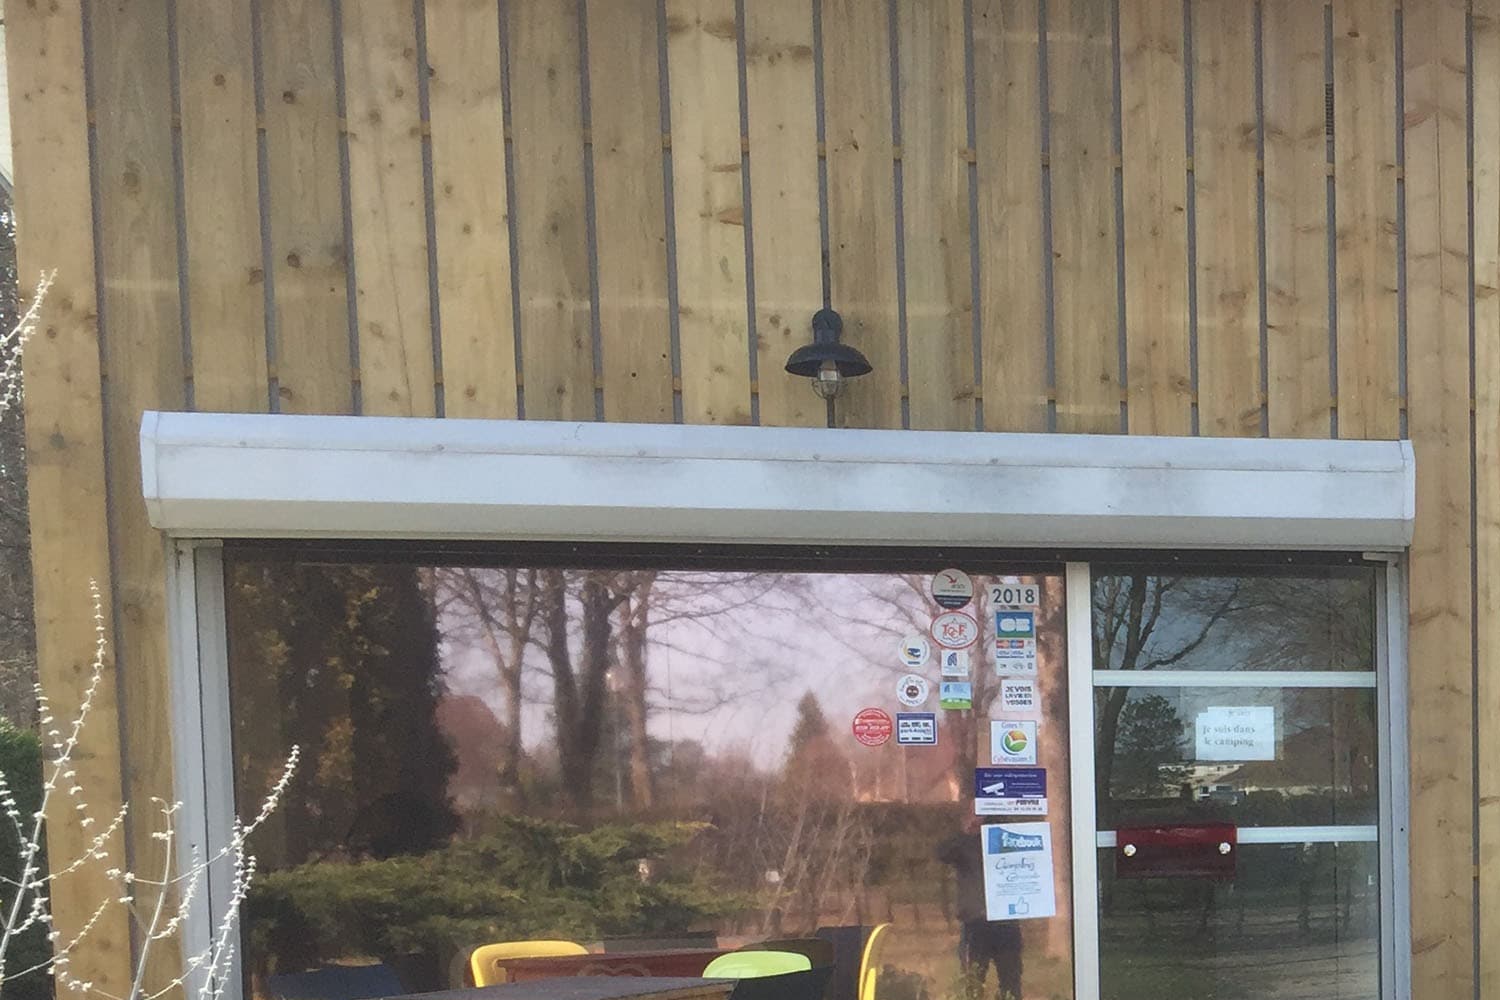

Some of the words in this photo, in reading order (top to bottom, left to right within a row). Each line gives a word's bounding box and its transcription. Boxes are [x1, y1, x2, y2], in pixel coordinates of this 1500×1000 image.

[992, 588, 1035, 604] 2018
[1214, 725, 1231, 733] suis
[1233, 725, 1256, 733] dans
[1214, 738, 1254, 747] camping
[1001, 832, 1042, 848] facebook
